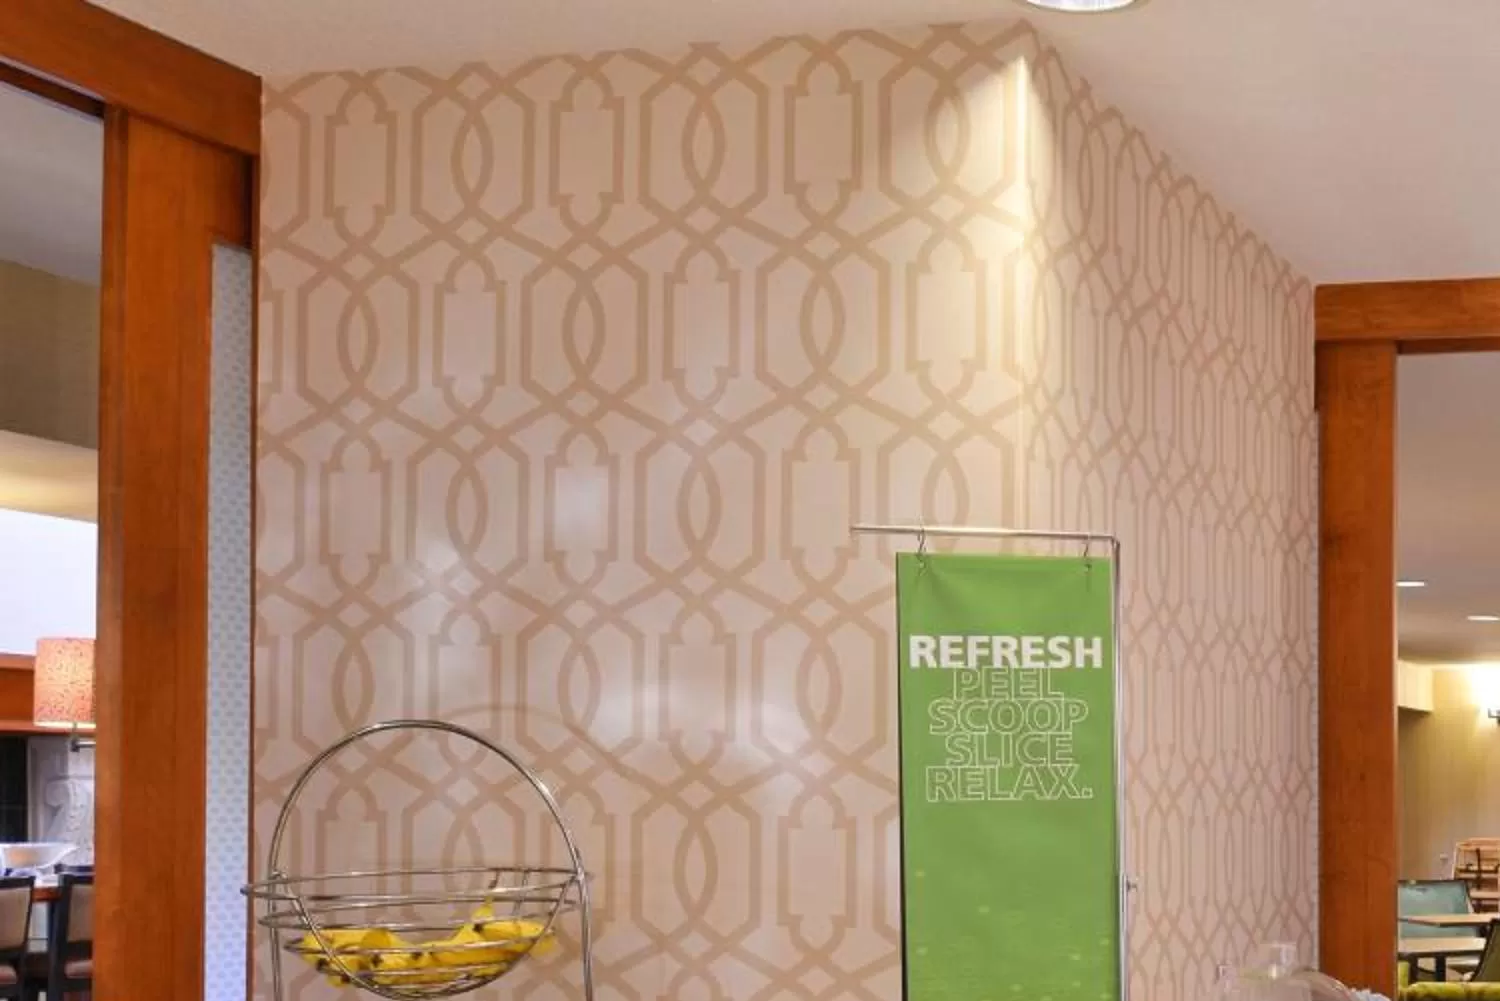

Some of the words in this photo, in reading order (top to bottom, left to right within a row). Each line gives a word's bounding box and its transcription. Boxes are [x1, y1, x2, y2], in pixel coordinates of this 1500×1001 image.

[909, 635, 1103, 669] REFRESH
[953, 667, 1064, 700] PEEL
[928, 700, 1089, 734] SCOOP
[945, 732, 1074, 767] SLICE
[926, 766, 1093, 802] RELAX.
